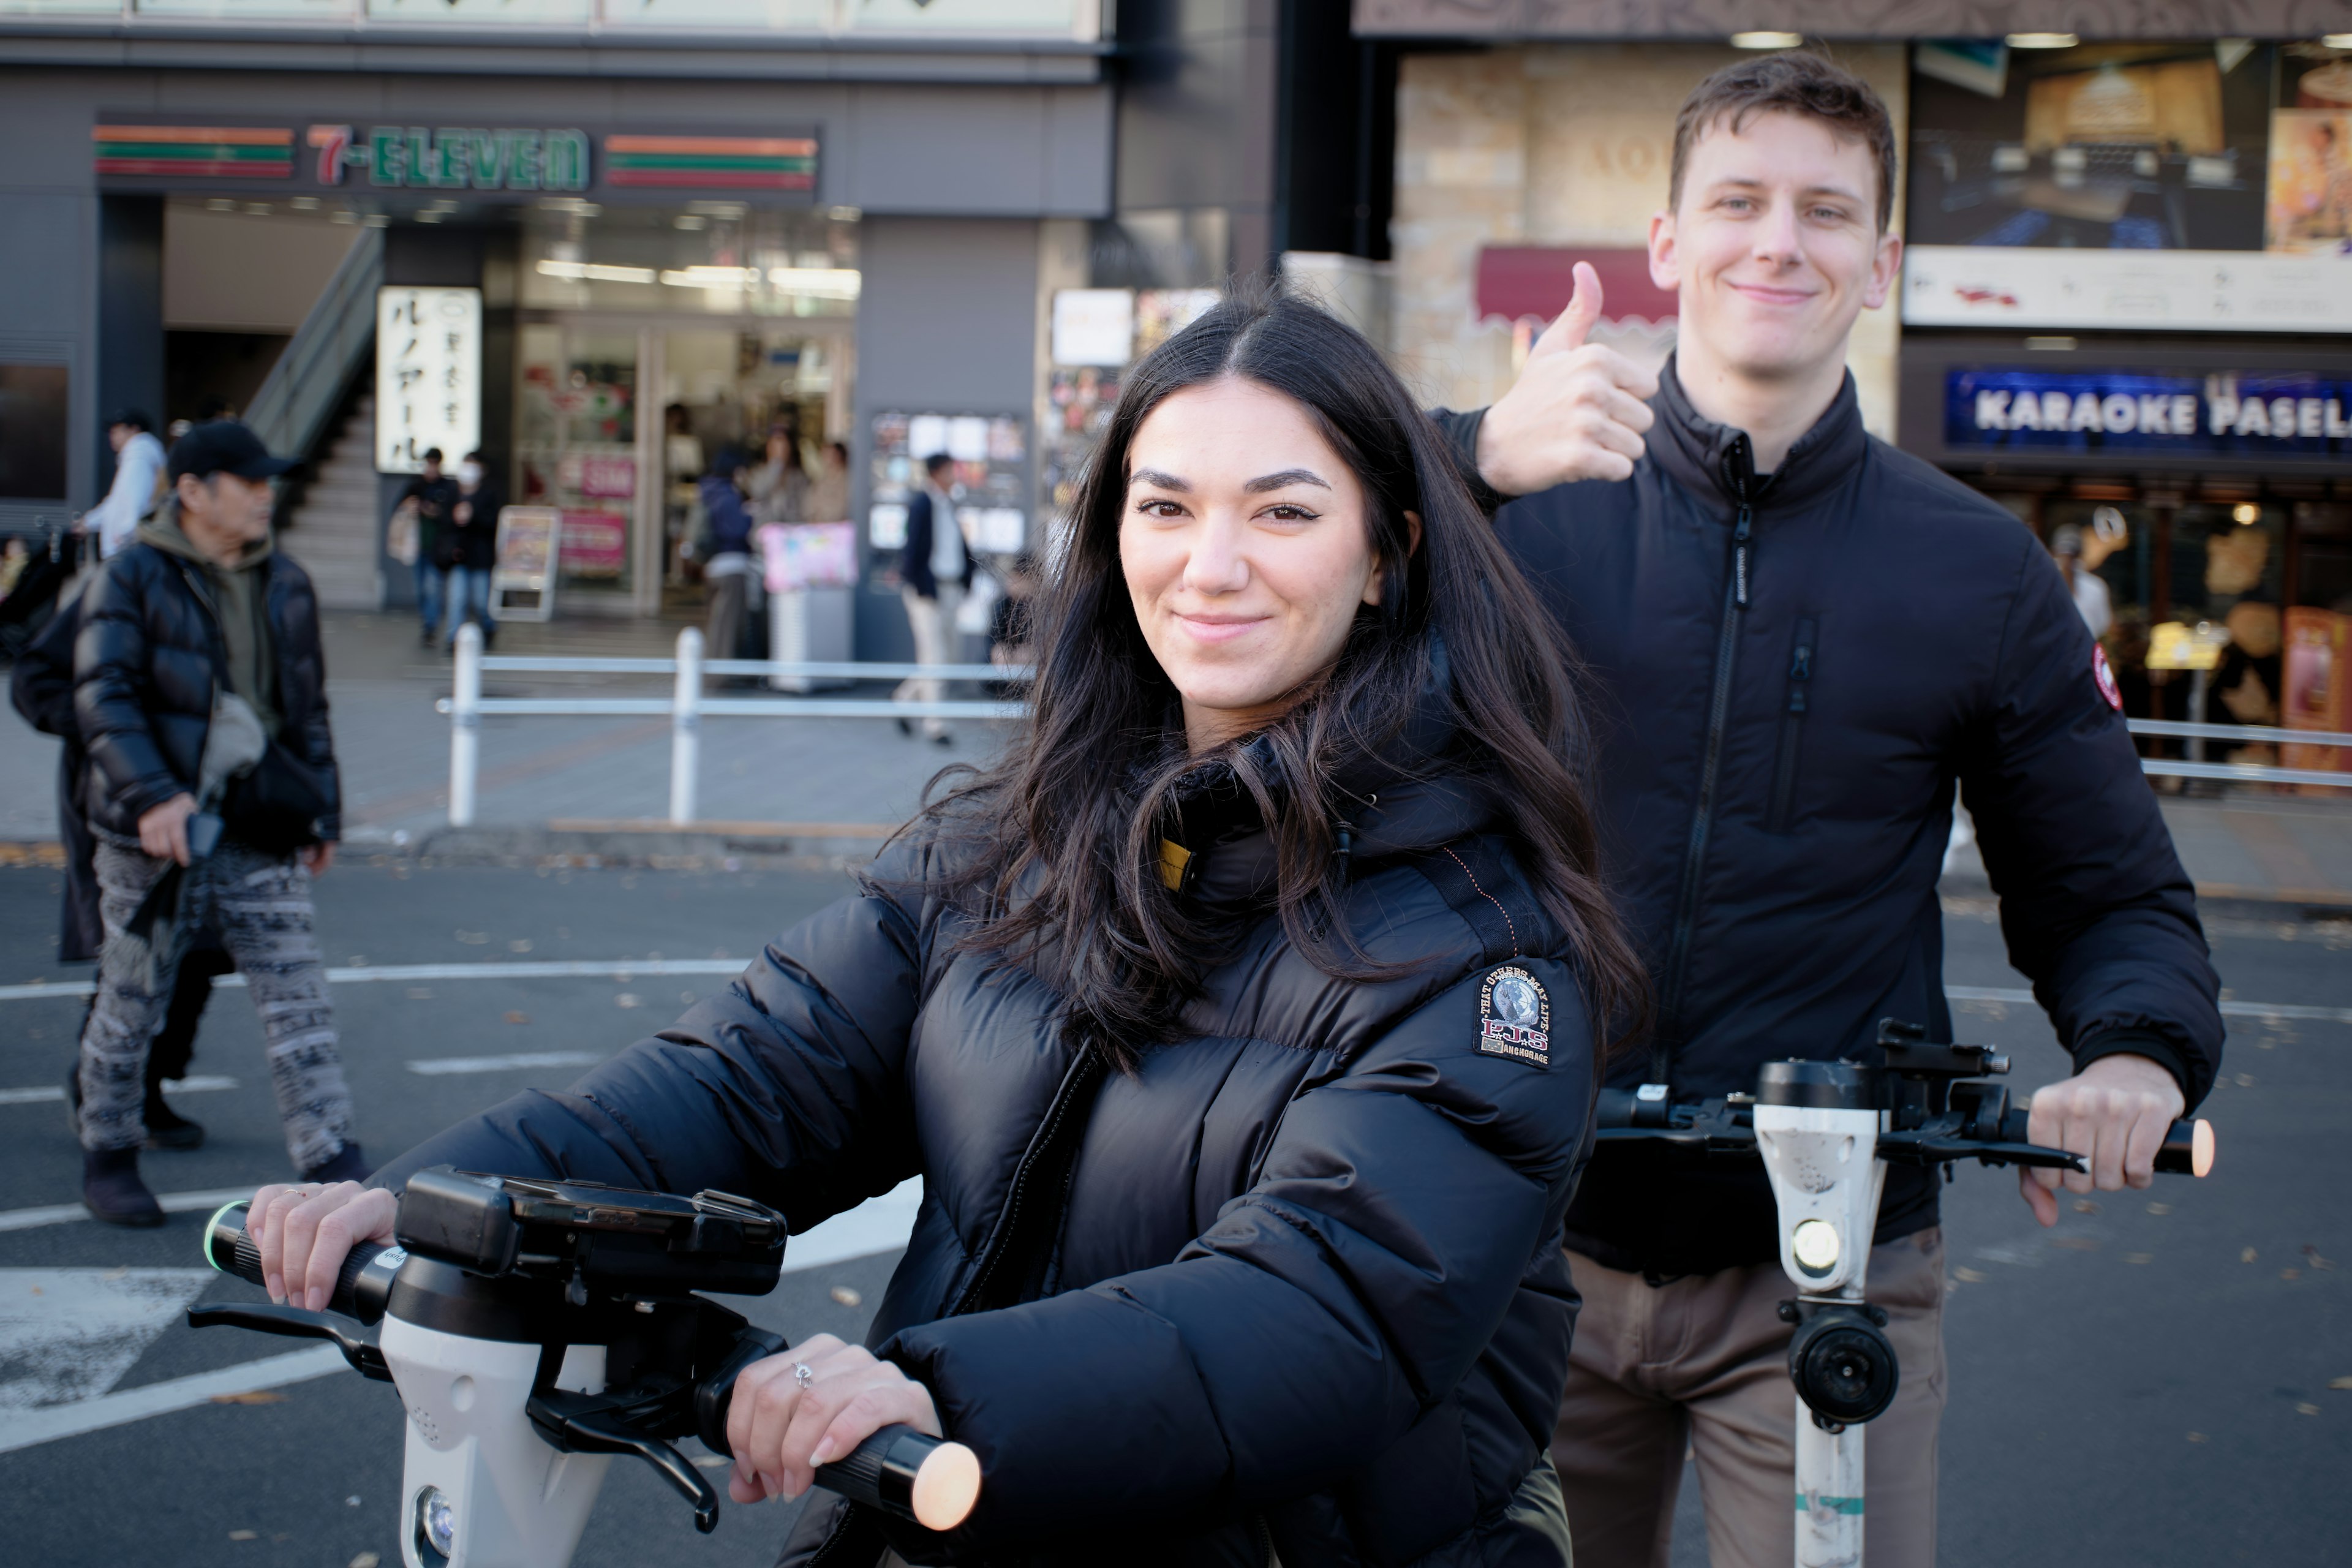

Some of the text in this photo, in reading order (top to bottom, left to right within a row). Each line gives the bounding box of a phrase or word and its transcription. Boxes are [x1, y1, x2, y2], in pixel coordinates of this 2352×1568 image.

[1976, 390, 2197, 434] KARAOKE
[1480, 967, 1549, 1030] THAT OTHERS MAY LIVE
[1503, 1044, 1549, 1065] ANCHORAGE
